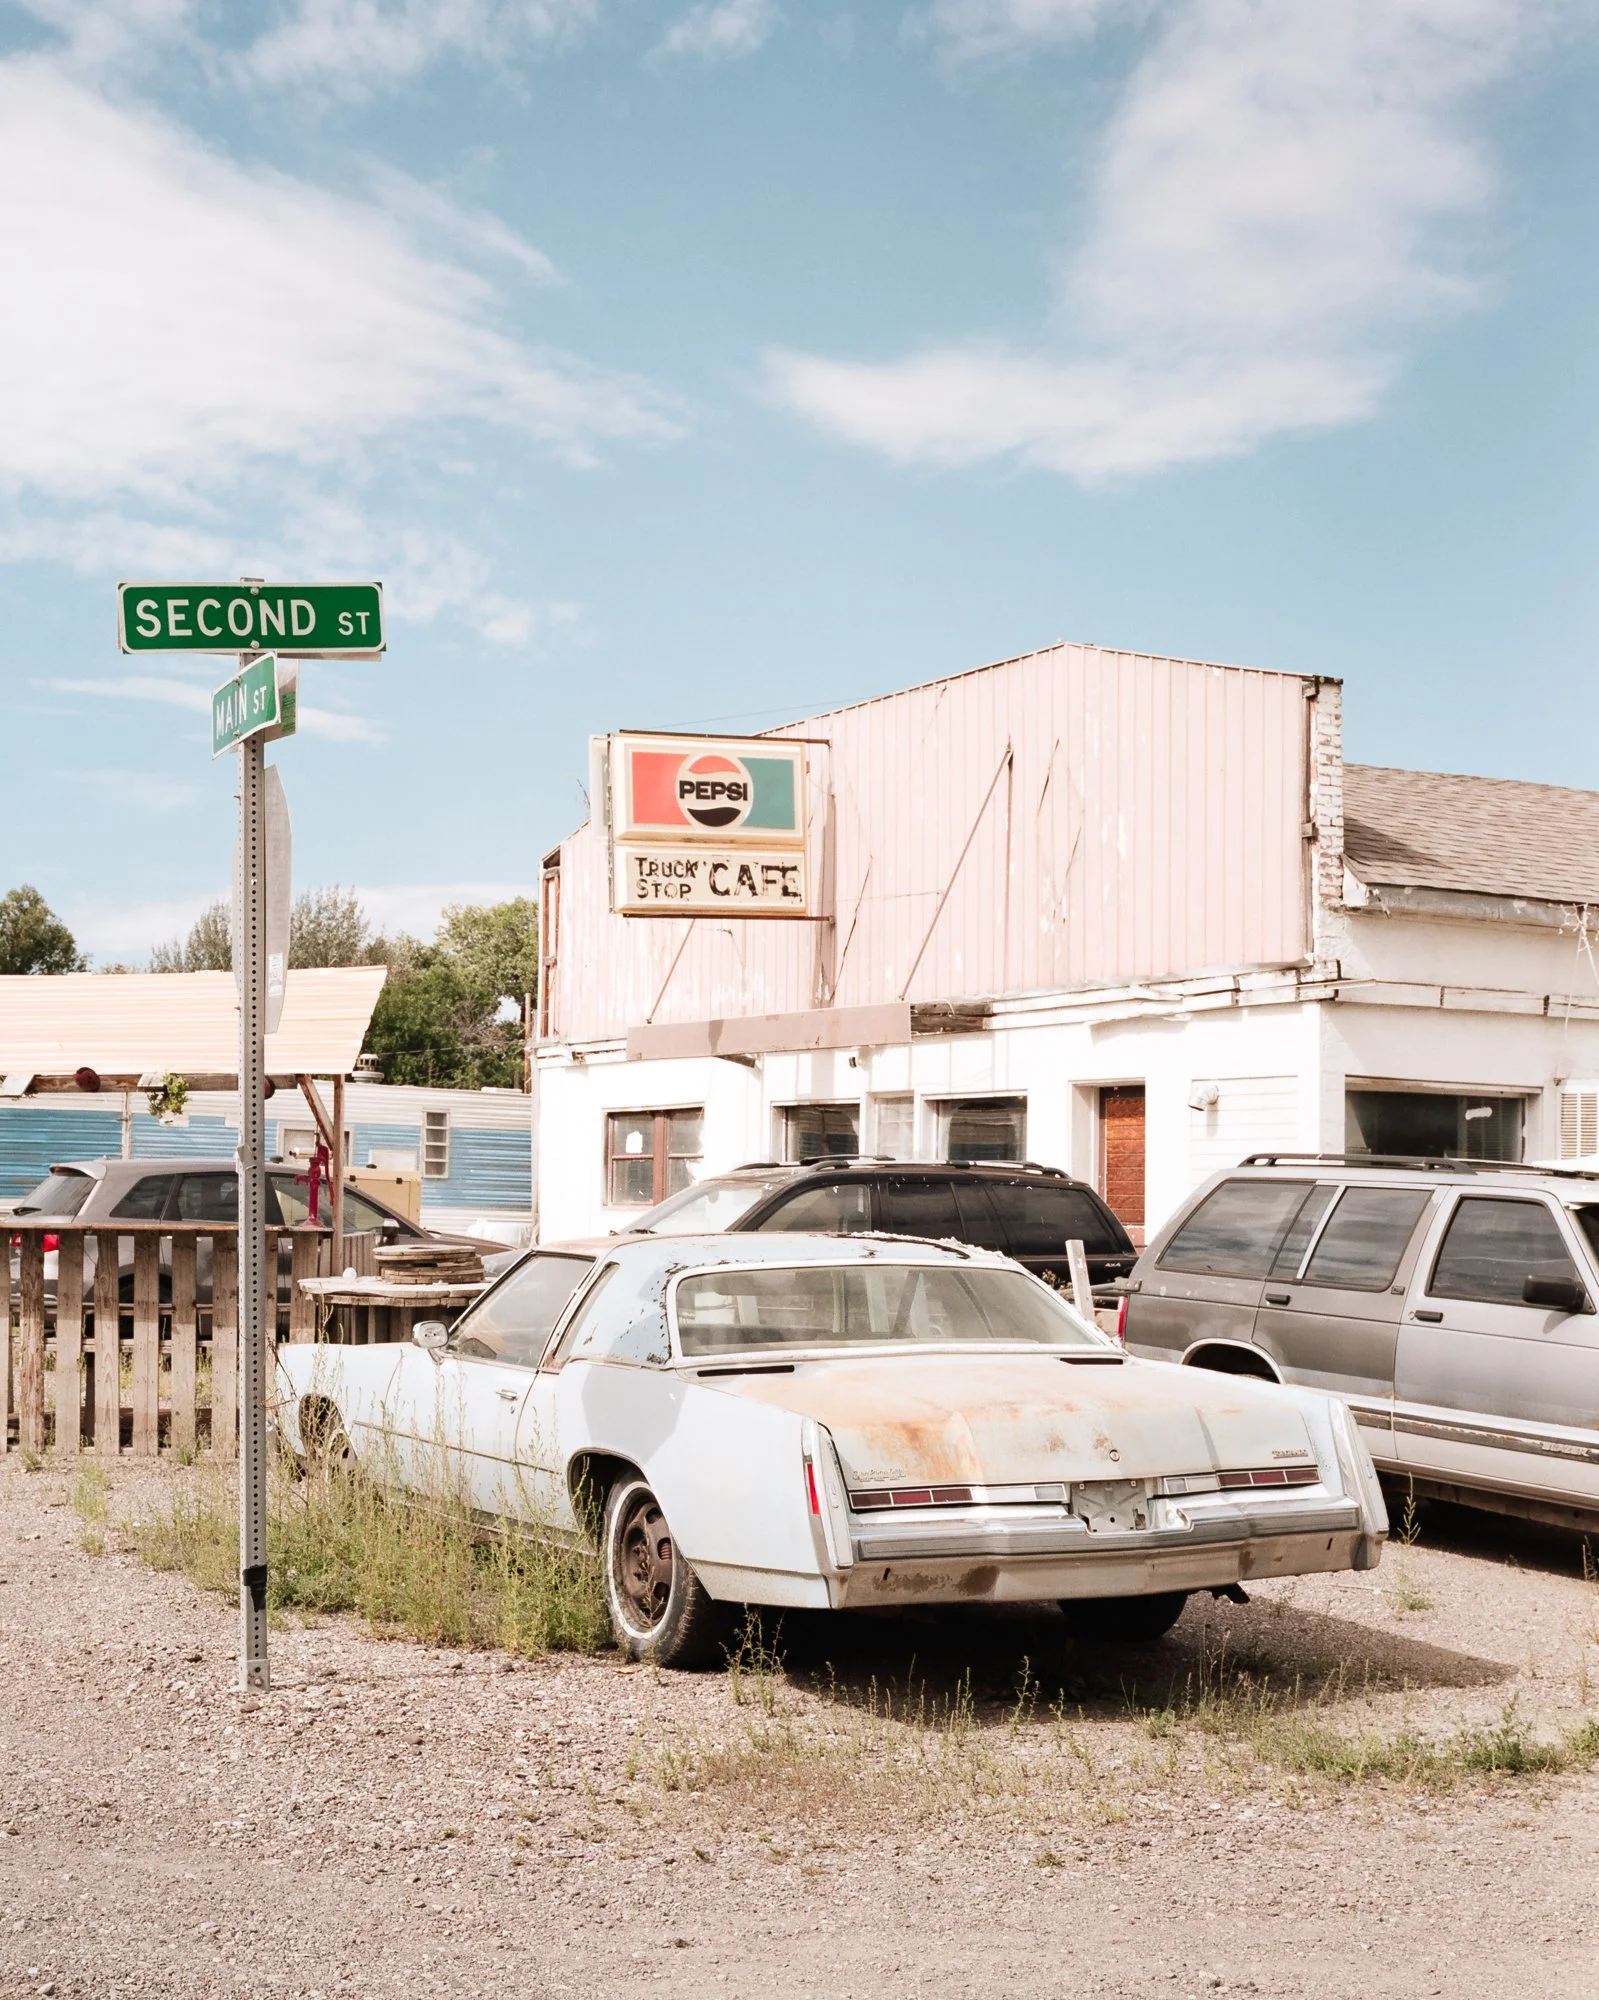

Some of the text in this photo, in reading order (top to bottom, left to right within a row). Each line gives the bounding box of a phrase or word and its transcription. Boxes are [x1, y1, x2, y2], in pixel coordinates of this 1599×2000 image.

[135, 598, 370, 637] SECOND ST
[216, 684, 247, 740] MAIN
[253, 685, 267, 715] ST
[679, 780, 748, 801] PEPSI
[635, 857, 698, 878] TRUCK
[709, 862, 801, 898] CAFE
[636, 878, 692, 899] STOP
